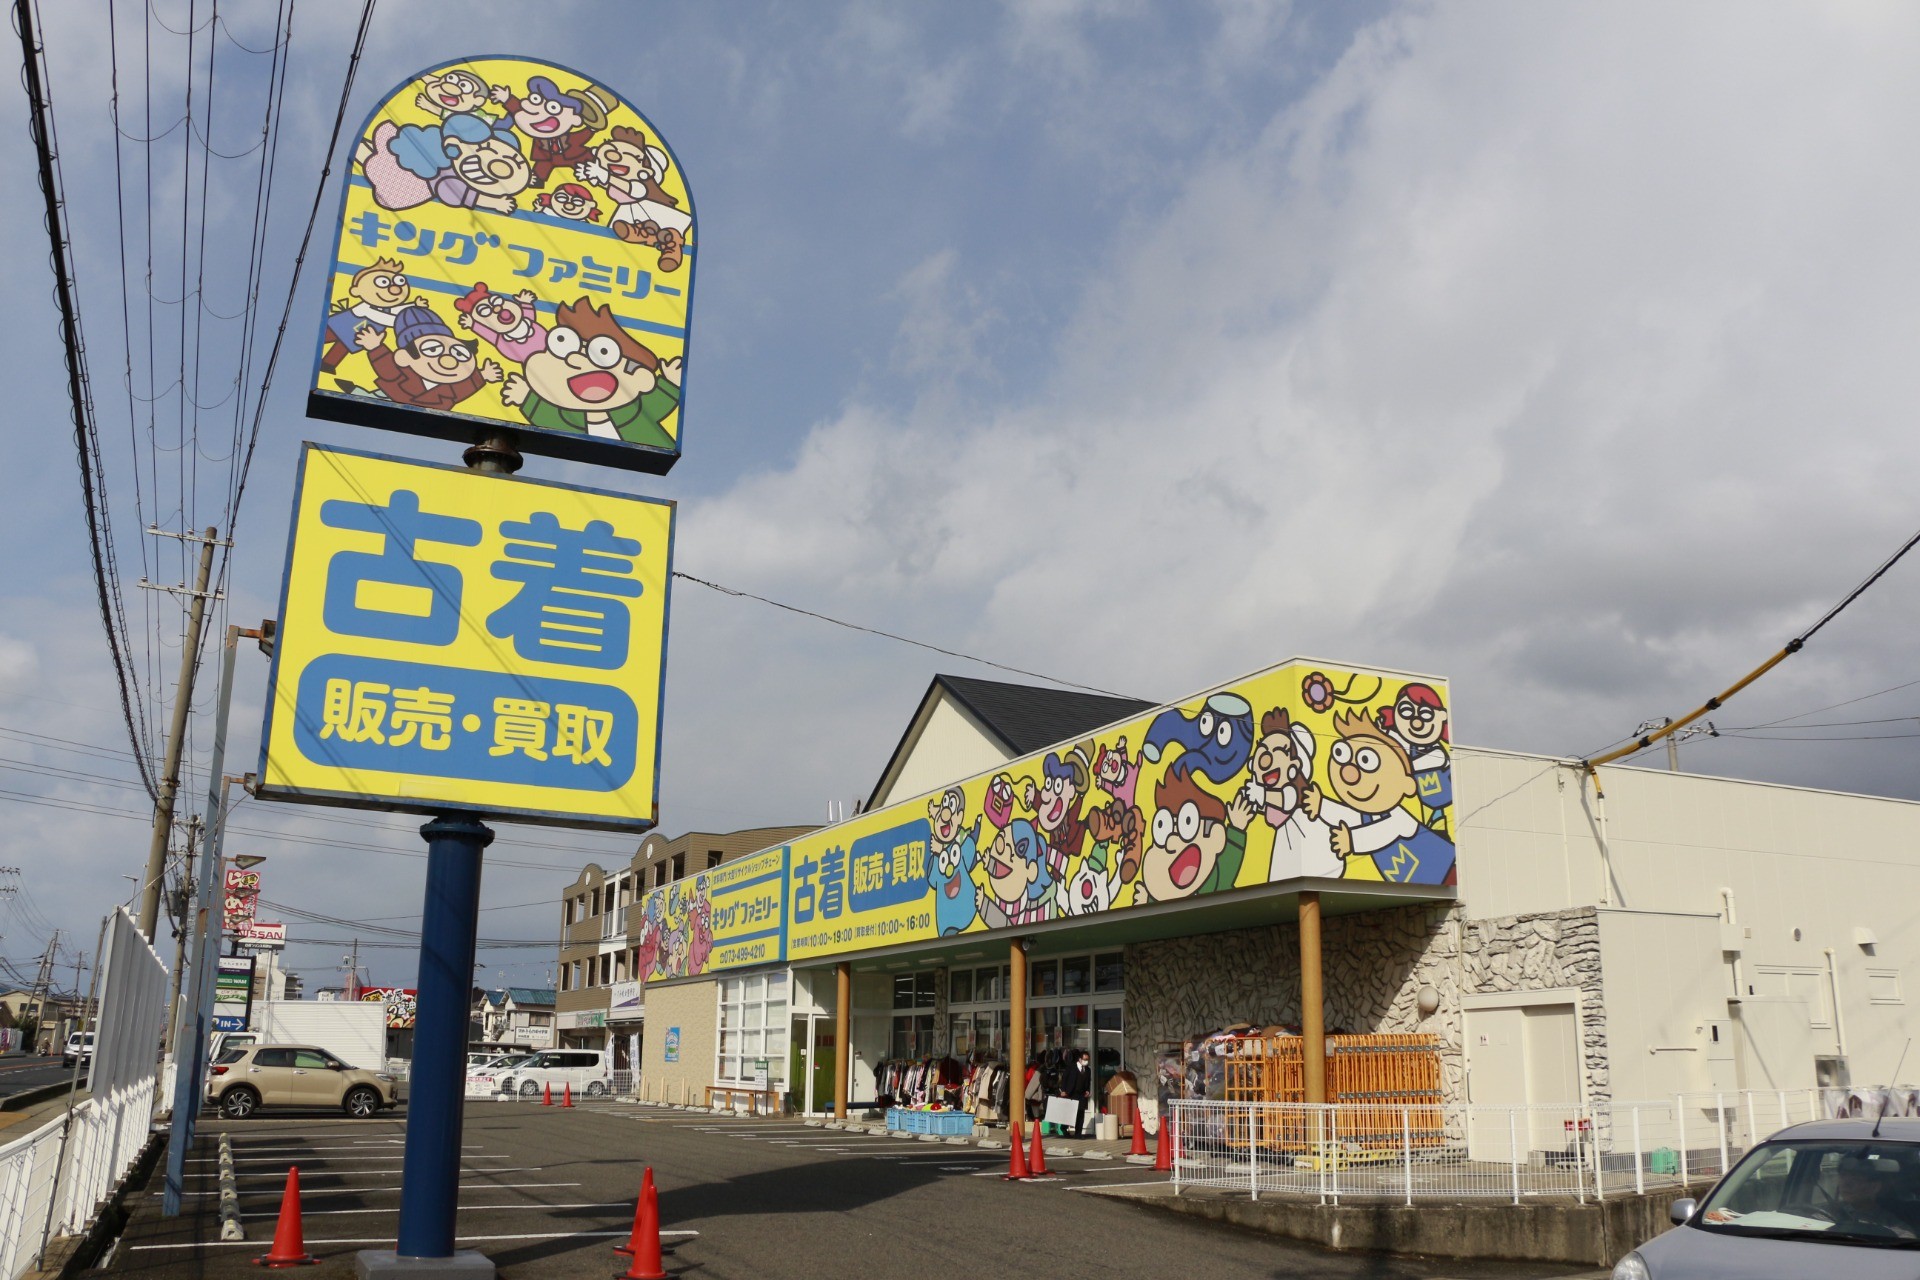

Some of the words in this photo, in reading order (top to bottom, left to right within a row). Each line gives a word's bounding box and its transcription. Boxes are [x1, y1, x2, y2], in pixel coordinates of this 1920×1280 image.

[349, 210, 681, 300] キングファミリー
[319, 489, 645, 671] 古着
[319, 677, 614, 768] 販売・買取
[793, 844, 846, 924] 古着
[852, 840, 926, 895] 販売・買取
[237, 930, 283, 940] NISSAN
[712, 895, 778, 931] キングファミリー
[723, 943, 766, 964] 073-499-4210
[220, 1020, 231, 1028] IN
